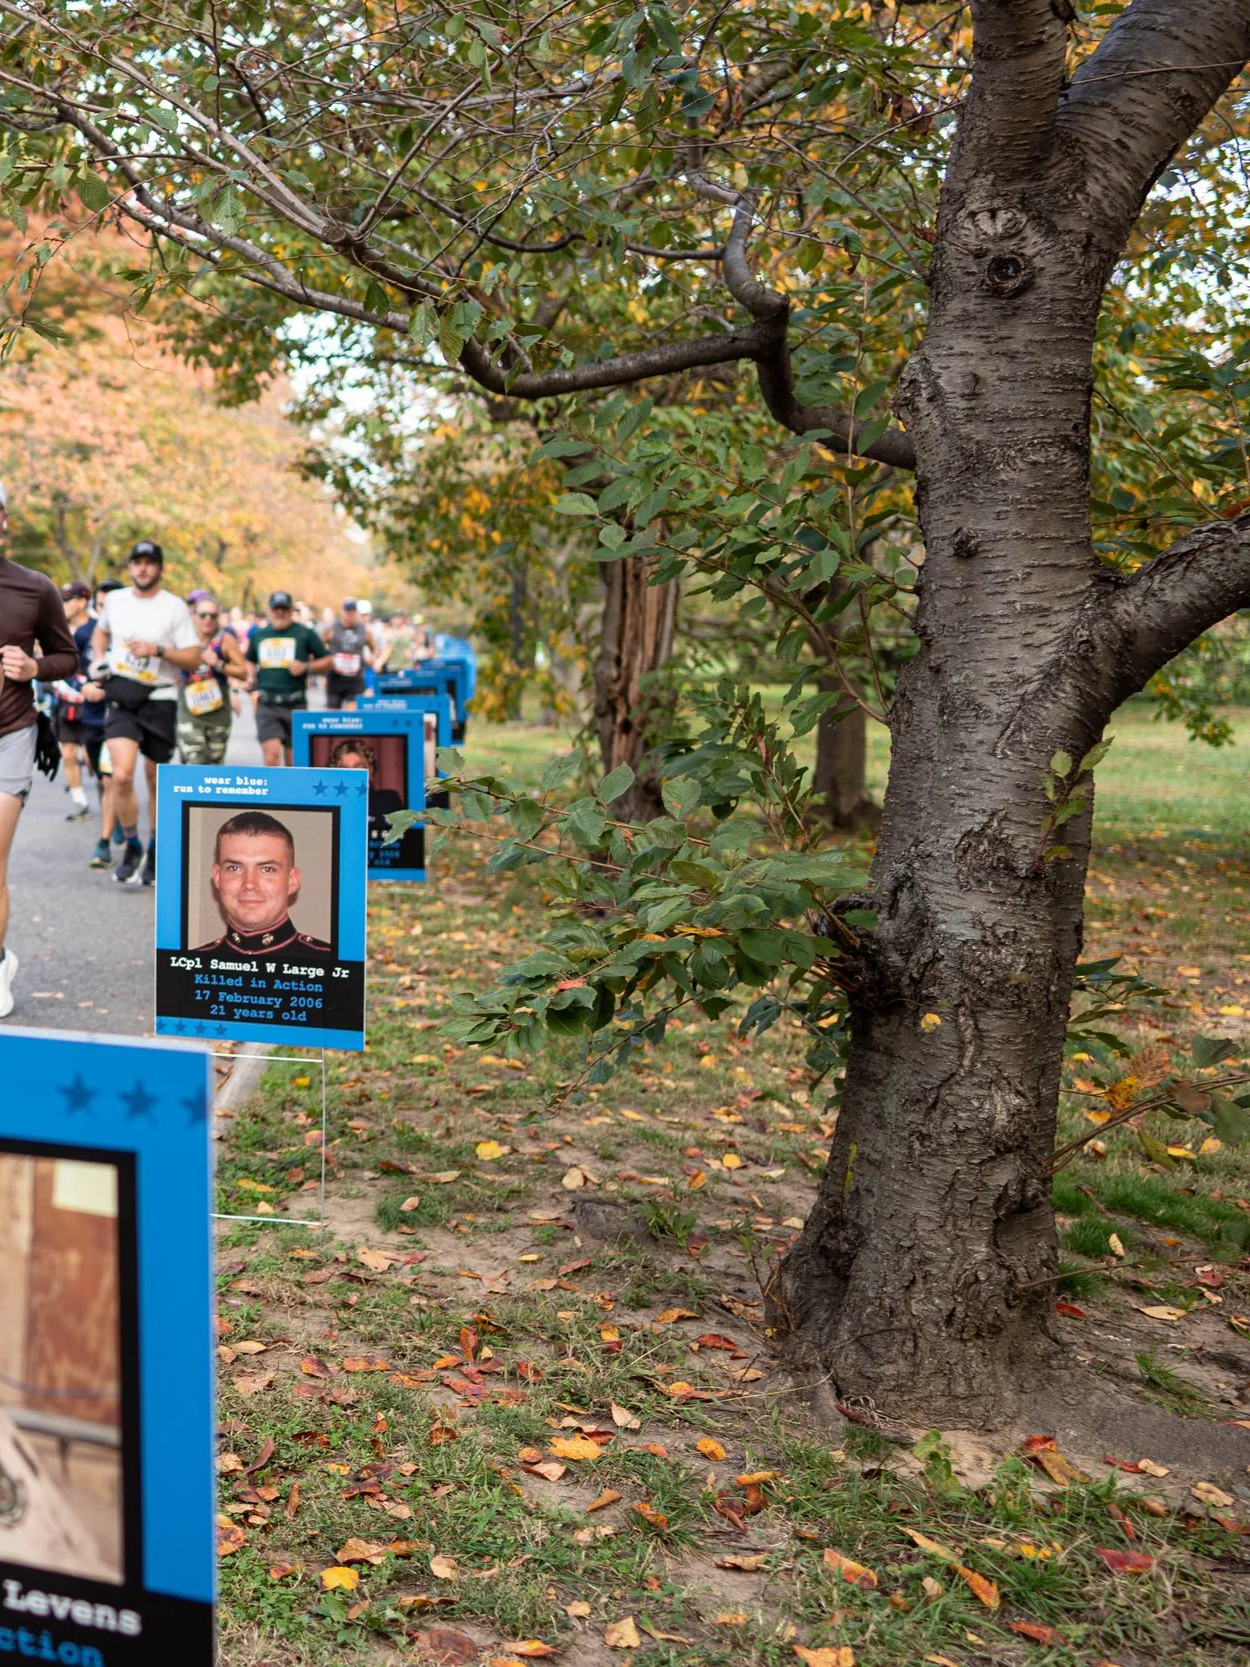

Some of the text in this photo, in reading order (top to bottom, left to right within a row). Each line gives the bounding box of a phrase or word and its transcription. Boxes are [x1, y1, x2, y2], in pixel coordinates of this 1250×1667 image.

[173, 785, 269, 795] run to remember
[204, 776, 268, 786] wear blue:
[170, 956, 350, 978] LCpl Samuel W Large Jr
[194, 974, 323, 993] Killed in Action
[194, 990, 323, 1009] 17 February 2006
[210, 1005, 307, 1022] 21 years old
[2, 1579, 143, 1637] Levens
